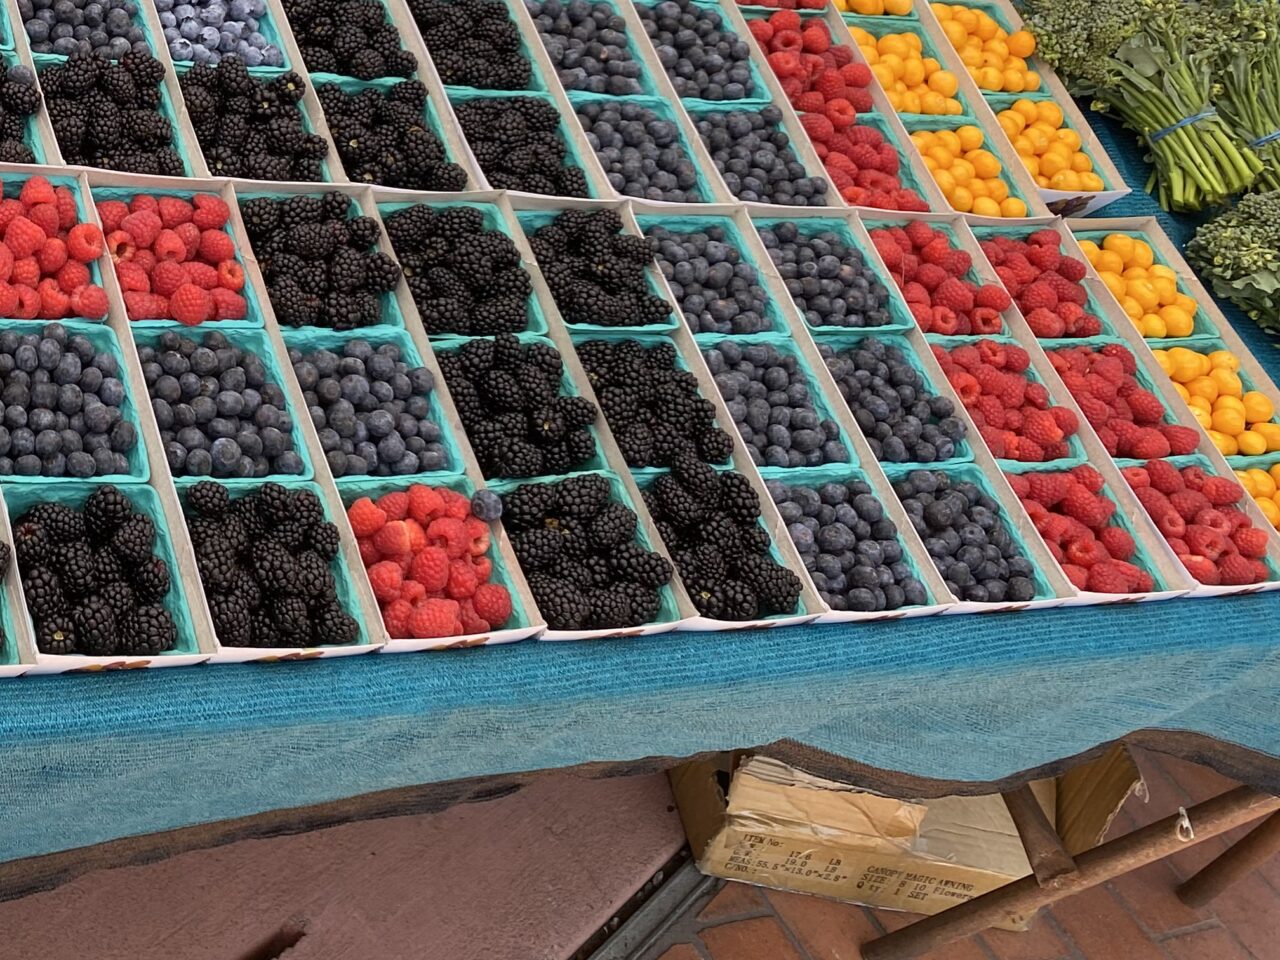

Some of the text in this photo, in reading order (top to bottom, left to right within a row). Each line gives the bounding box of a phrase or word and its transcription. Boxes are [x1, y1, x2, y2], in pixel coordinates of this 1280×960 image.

[743, 833, 766, 844] ITEM
[829, 858, 842, 867] LB
[824, 865, 838, 874] LB
[904, 872, 937, 885] MAGIC
[939, 879, 974, 892] AWNING
[908, 890, 928, 901] SET
